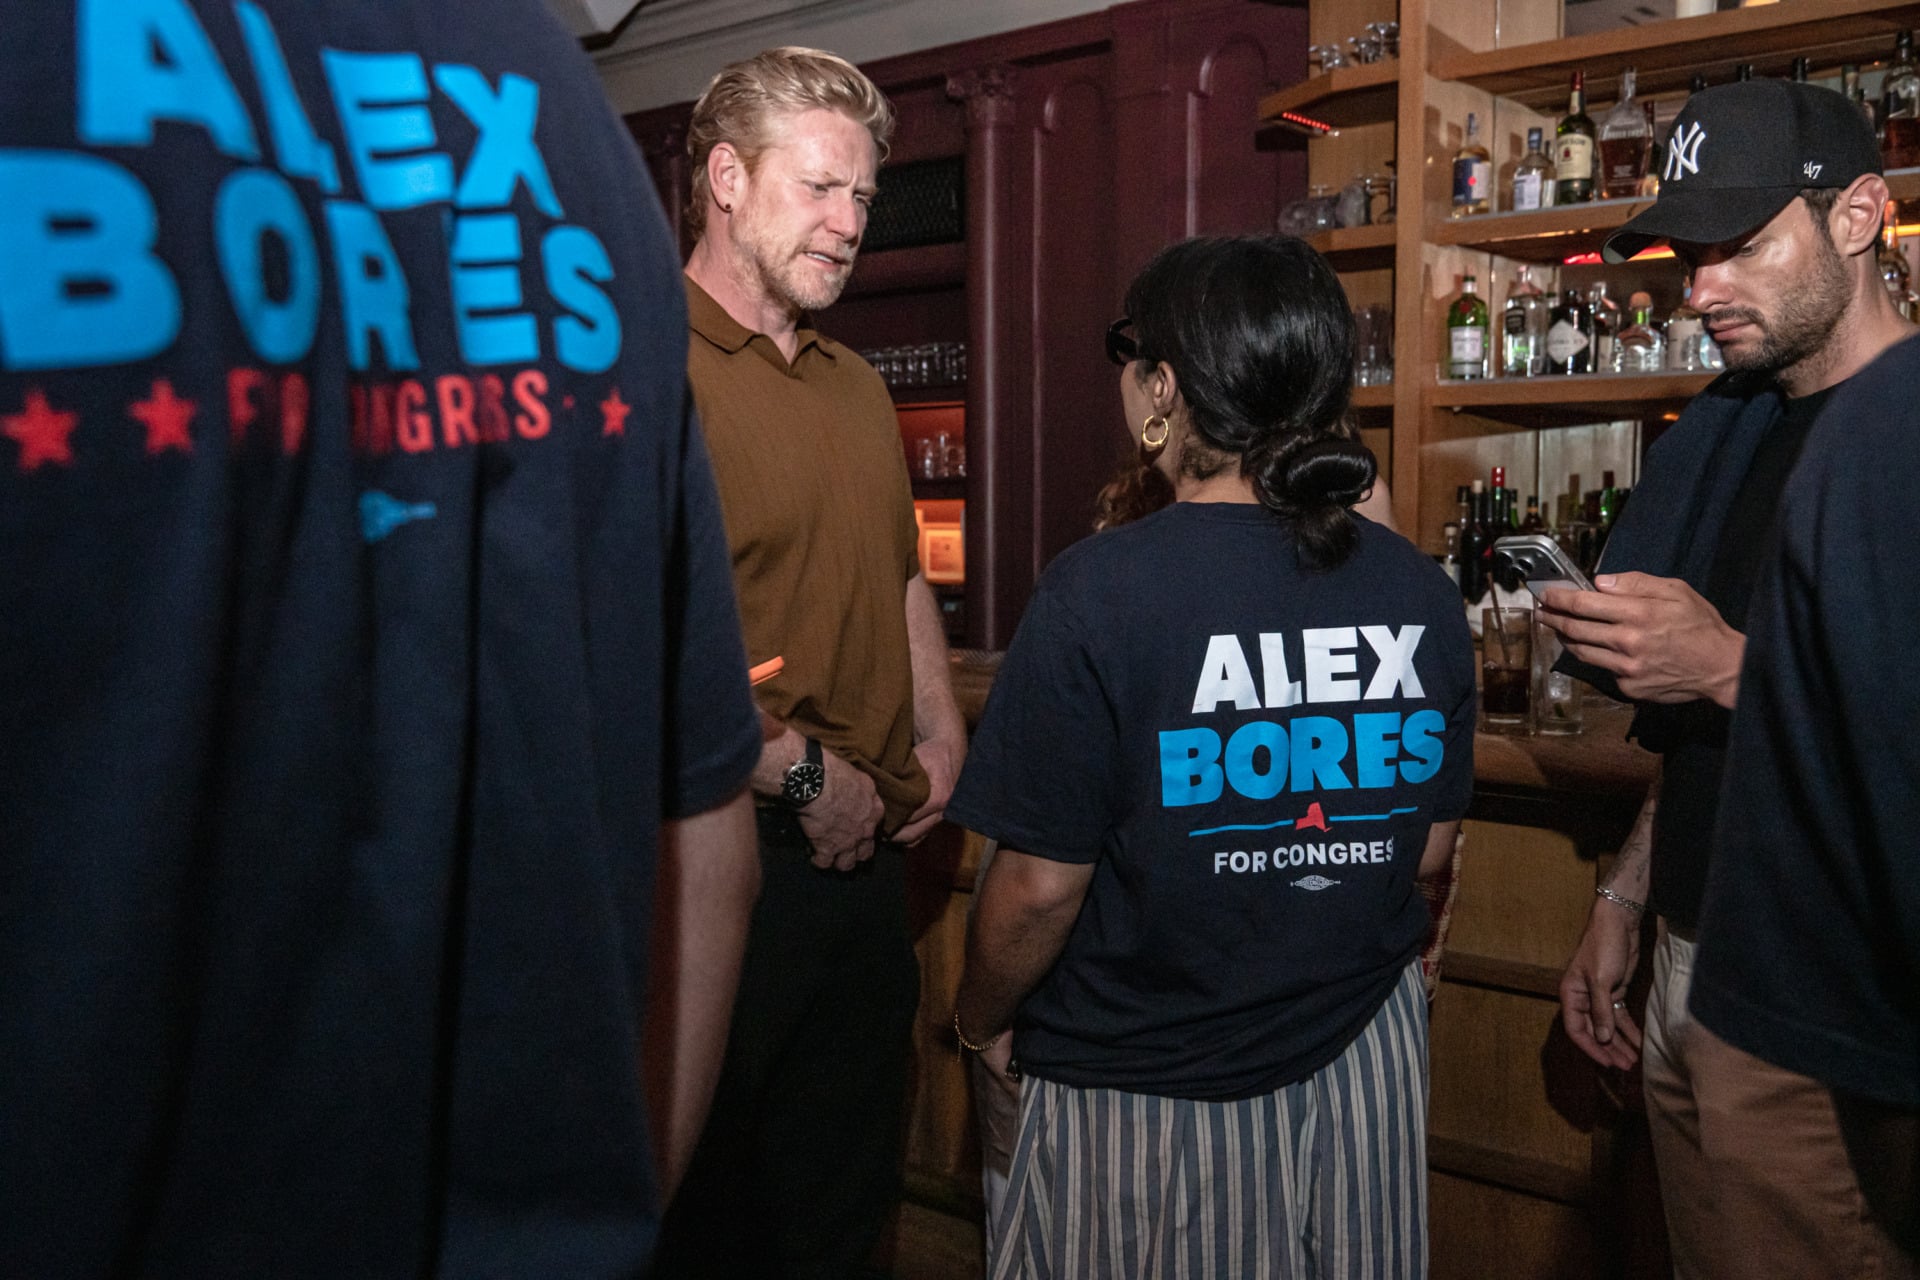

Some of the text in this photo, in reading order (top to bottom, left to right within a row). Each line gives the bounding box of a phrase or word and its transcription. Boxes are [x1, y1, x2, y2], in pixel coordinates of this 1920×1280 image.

[75, 0, 564, 219] ALEX
[1663, 121, 1706, 181] NY
[0, 146, 623, 374] BORES
[1191, 624, 1427, 714] ALEX
[1158, 709, 1447, 808] BORES
[1214, 850, 1268, 875] FOR
